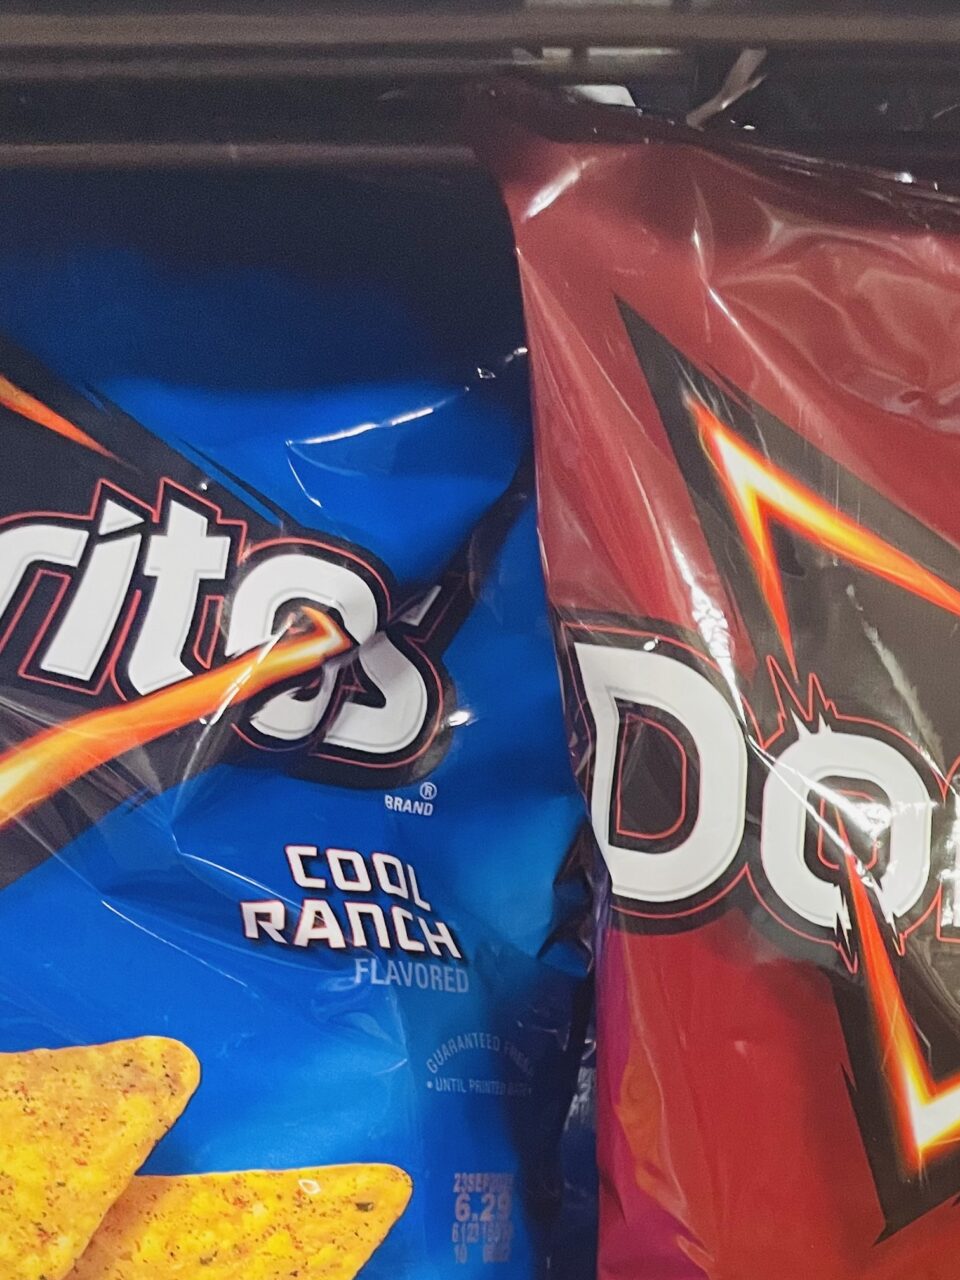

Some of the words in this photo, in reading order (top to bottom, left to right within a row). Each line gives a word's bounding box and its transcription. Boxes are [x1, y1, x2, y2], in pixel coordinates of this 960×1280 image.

[384, 795, 434, 816] BRAND
[286, 846, 431, 910] COOL
[241, 900, 462, 958] RANCH
[354, 958, 469, 994] FLAVORED
[426, 1032, 500, 1074] GUARANTEED
[436, 1078, 466, 1093] UNTIL
